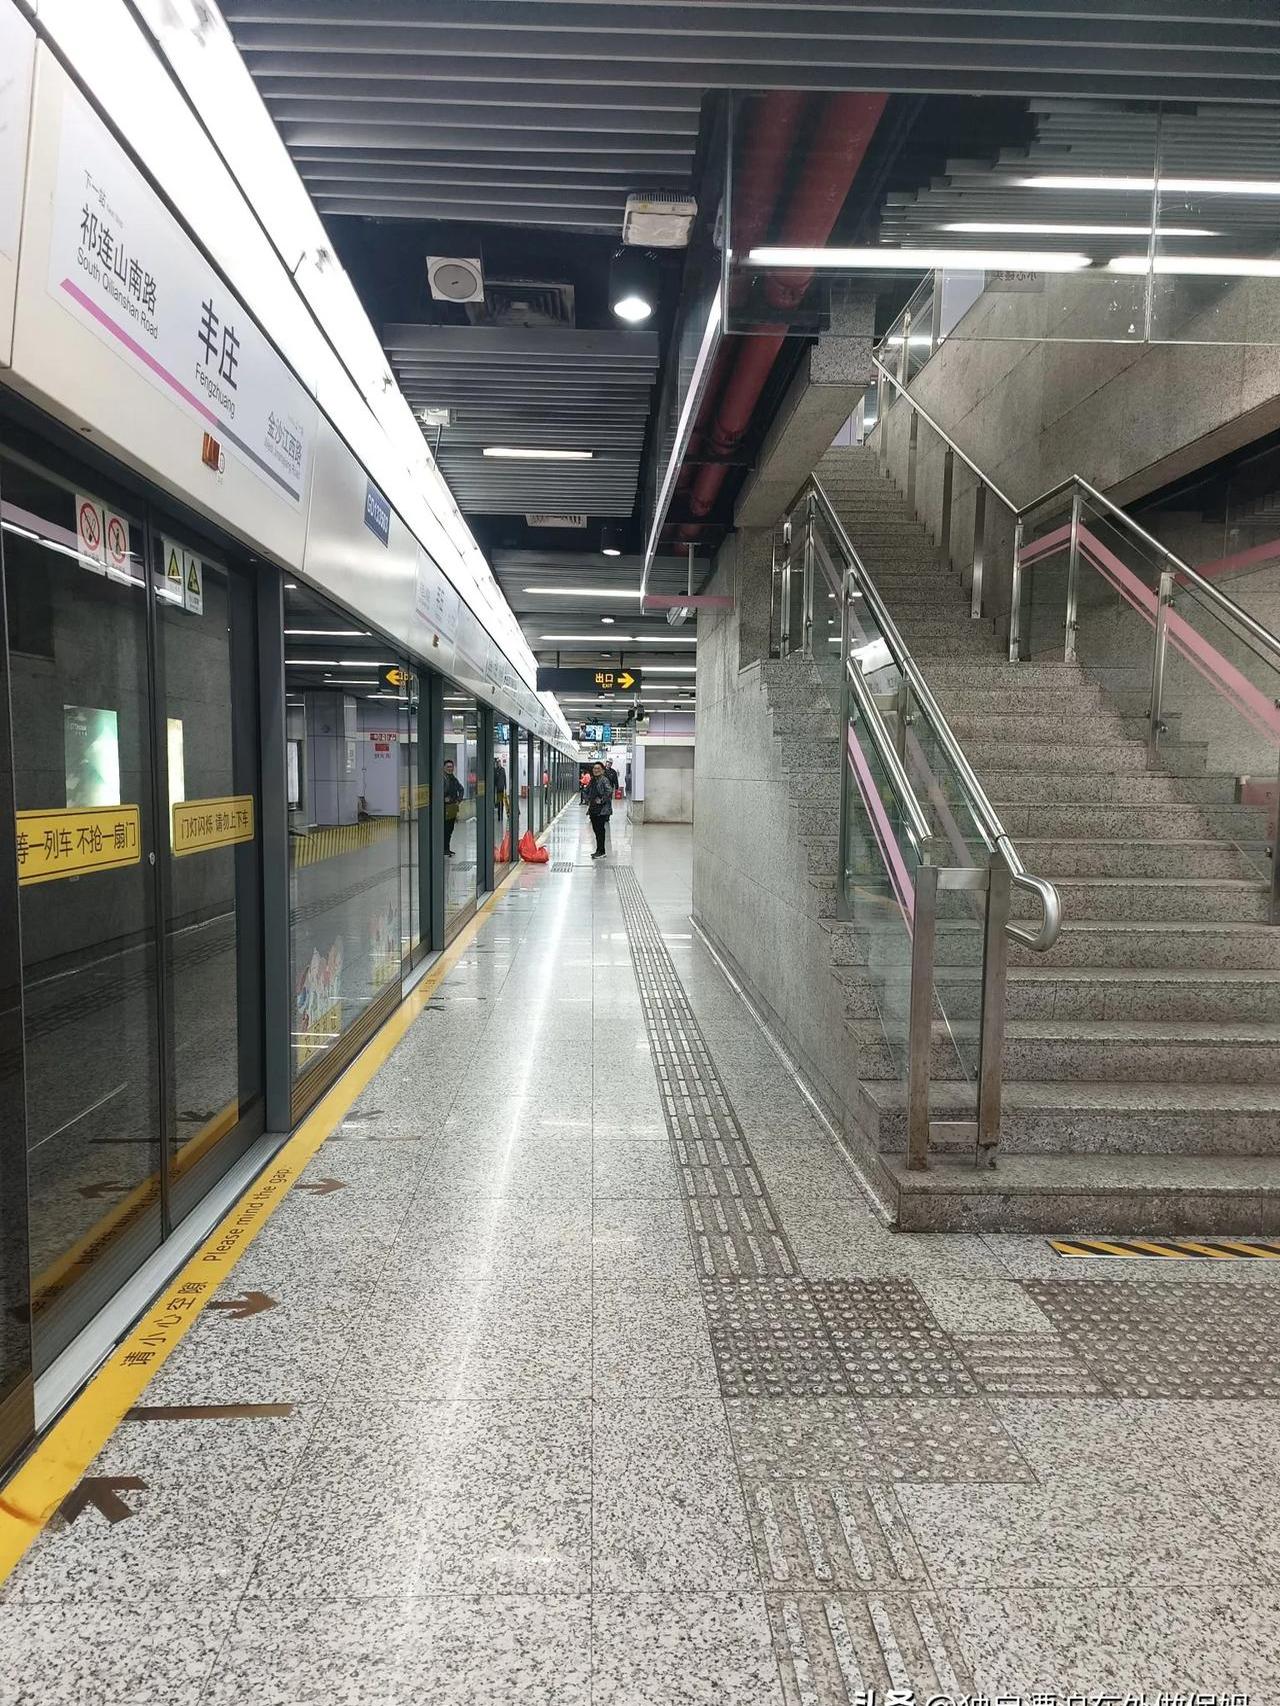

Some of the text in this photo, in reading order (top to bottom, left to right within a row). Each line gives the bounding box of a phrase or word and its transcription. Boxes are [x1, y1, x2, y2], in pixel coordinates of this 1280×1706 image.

[77, 246, 158, 340] South Qilianshan Road
[80, 203, 157, 316] 祁连山南路
[198, 298, 240, 391] 丰庄
[195, 362, 236, 420] Fengzhuang
[595, 672, 614, 683] 出口
[77, 821, 137, 856] 不抢一扇门
[181, 811, 249, 841] 门灯闪烁 请勿上下车
[120, 1281, 208, 1367] 请小心空隙
[203, 1227, 245, 1263] Please
[236, 1200, 264, 1226] mind
[253, 1184, 277, 1202] the
